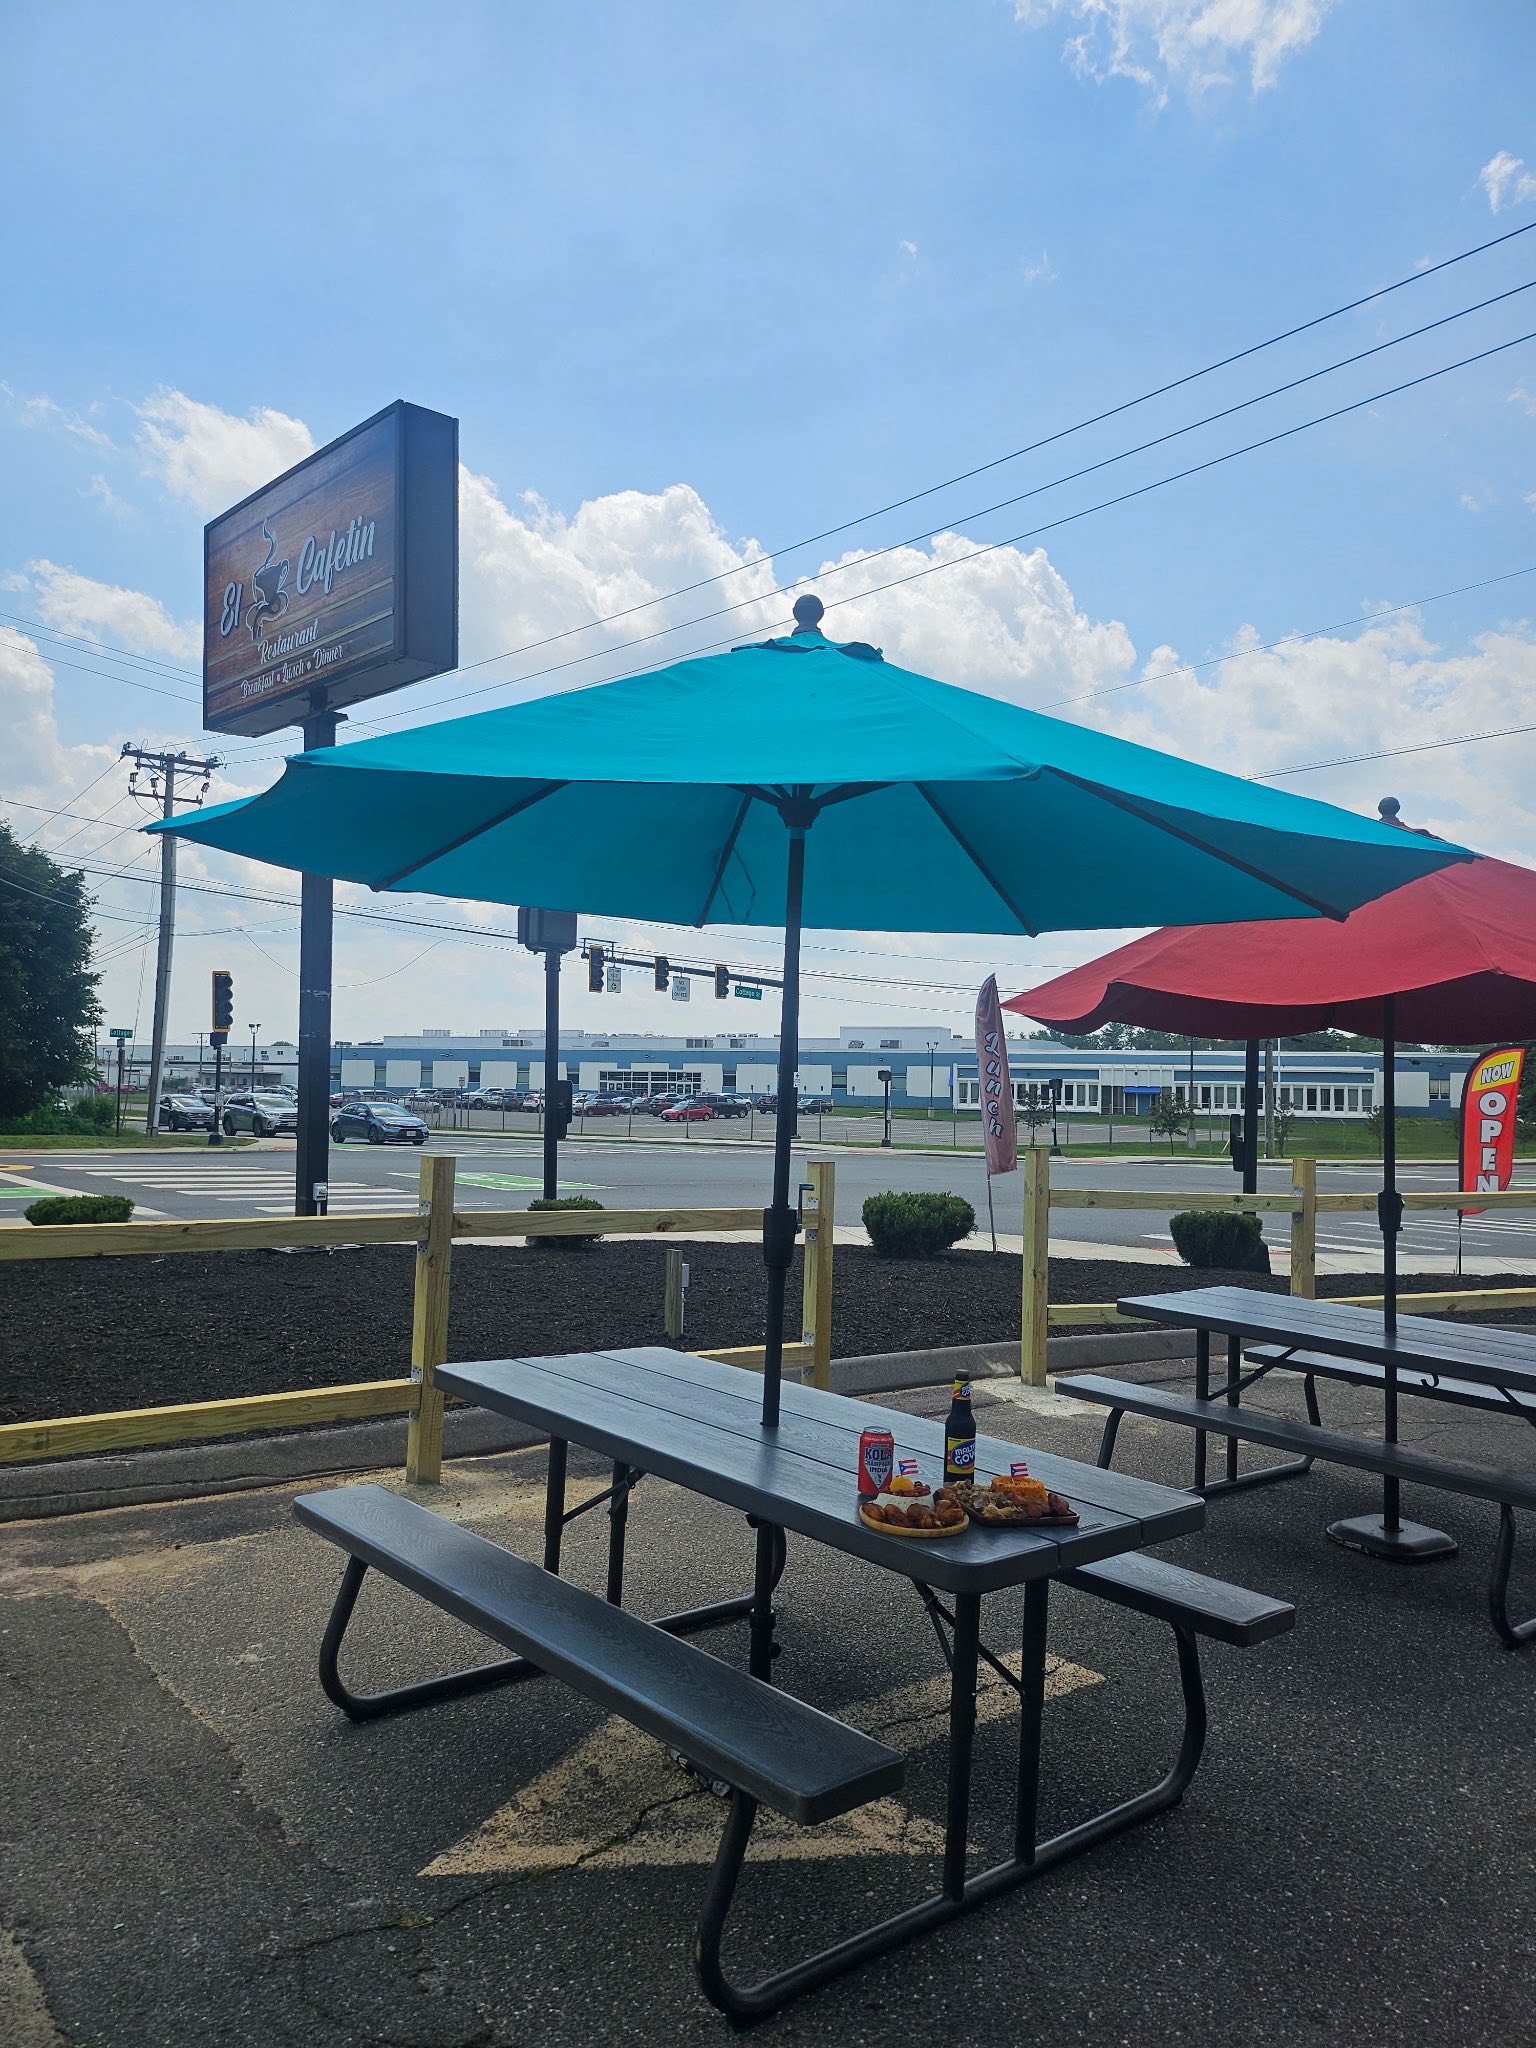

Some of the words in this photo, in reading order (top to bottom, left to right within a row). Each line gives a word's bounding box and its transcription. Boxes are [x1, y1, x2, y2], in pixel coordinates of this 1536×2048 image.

[221, 582, 242, 637] El
[257, 618, 319, 664] Restaurant
[240, 671, 275, 699] Breakfast
[282, 659, 305, 684] Lunch
[312, 644, 343, 670] Dinner
[985, 1031, 1003, 1138] Lunch
[1480, 1060, 1515, 1085] NOW
[1475, 1091, 1507, 1192] OPEN
[864, 1447, 893, 1461] KOLA
[954, 1450, 976, 1465] GOY
